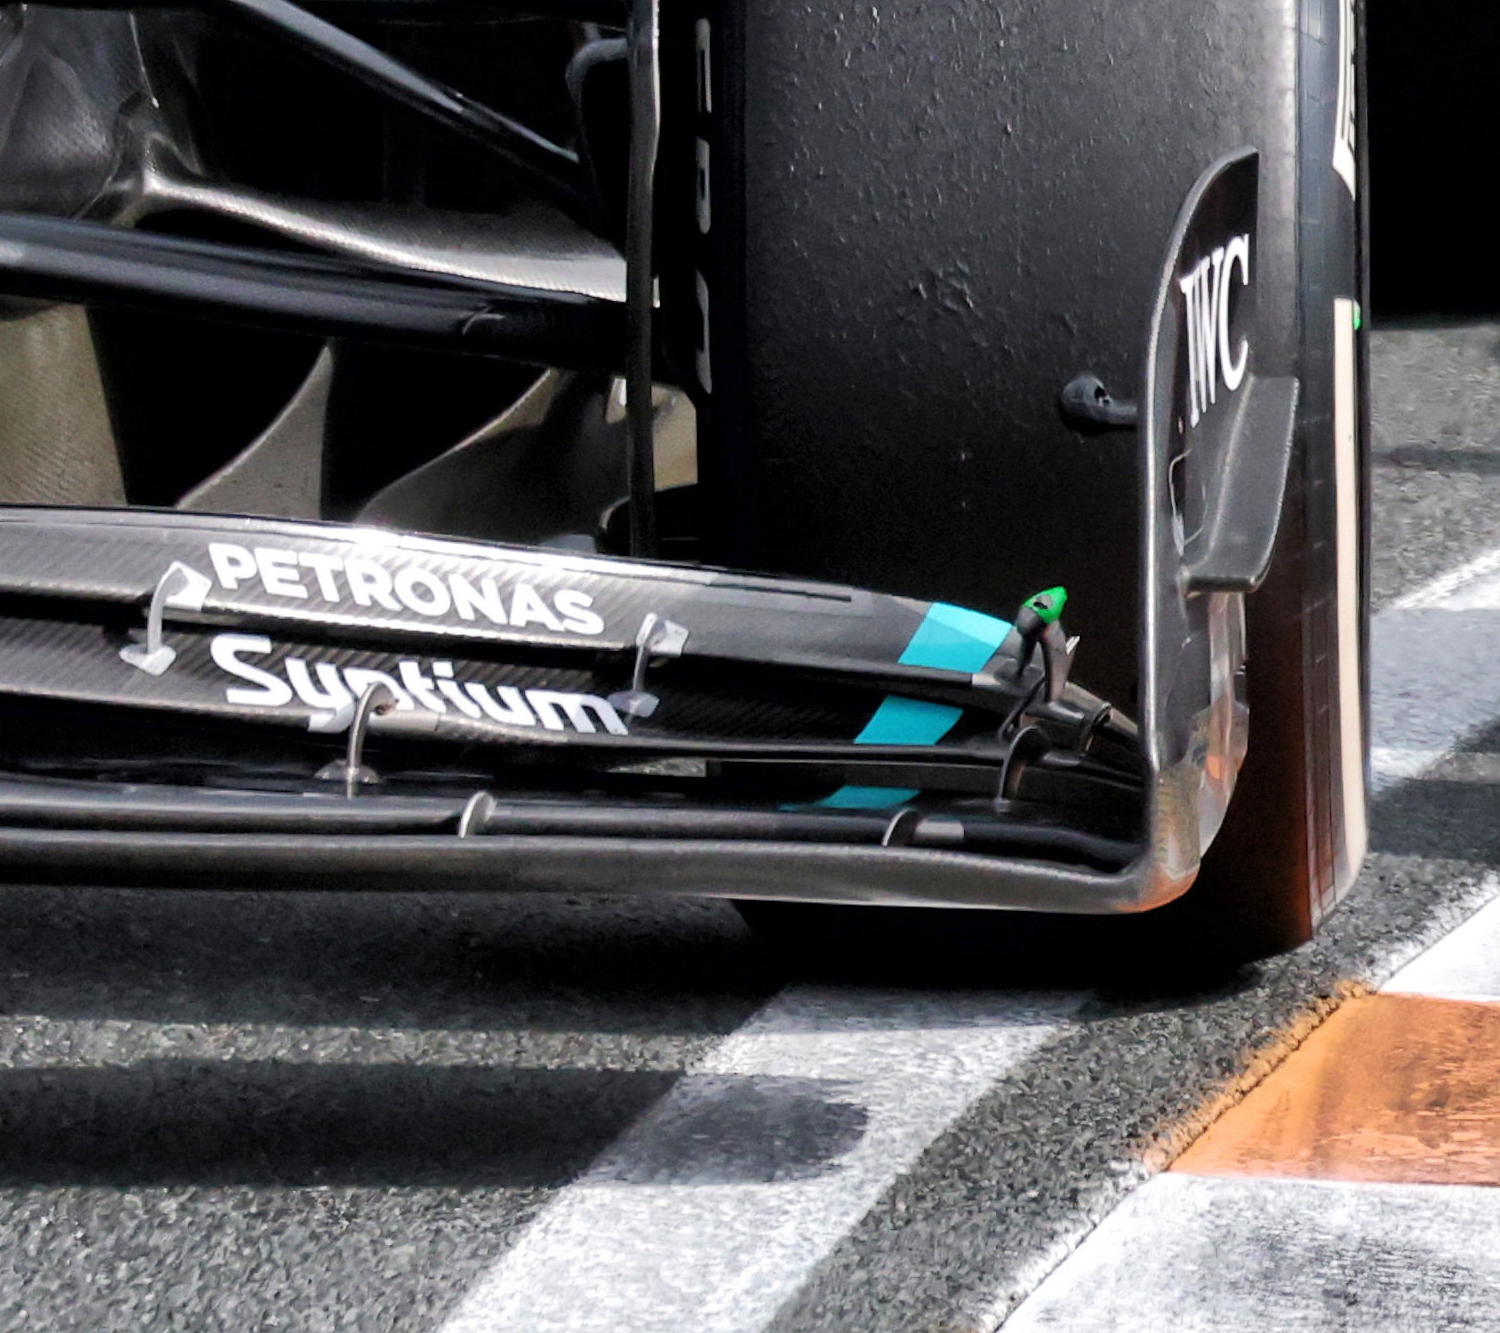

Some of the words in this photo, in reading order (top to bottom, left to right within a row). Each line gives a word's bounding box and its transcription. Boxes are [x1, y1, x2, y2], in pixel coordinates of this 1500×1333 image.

[1180, 235, 1250, 428] IWC
[208, 542, 603, 635] PETRONAS
[210, 633, 628, 734] Syntium
